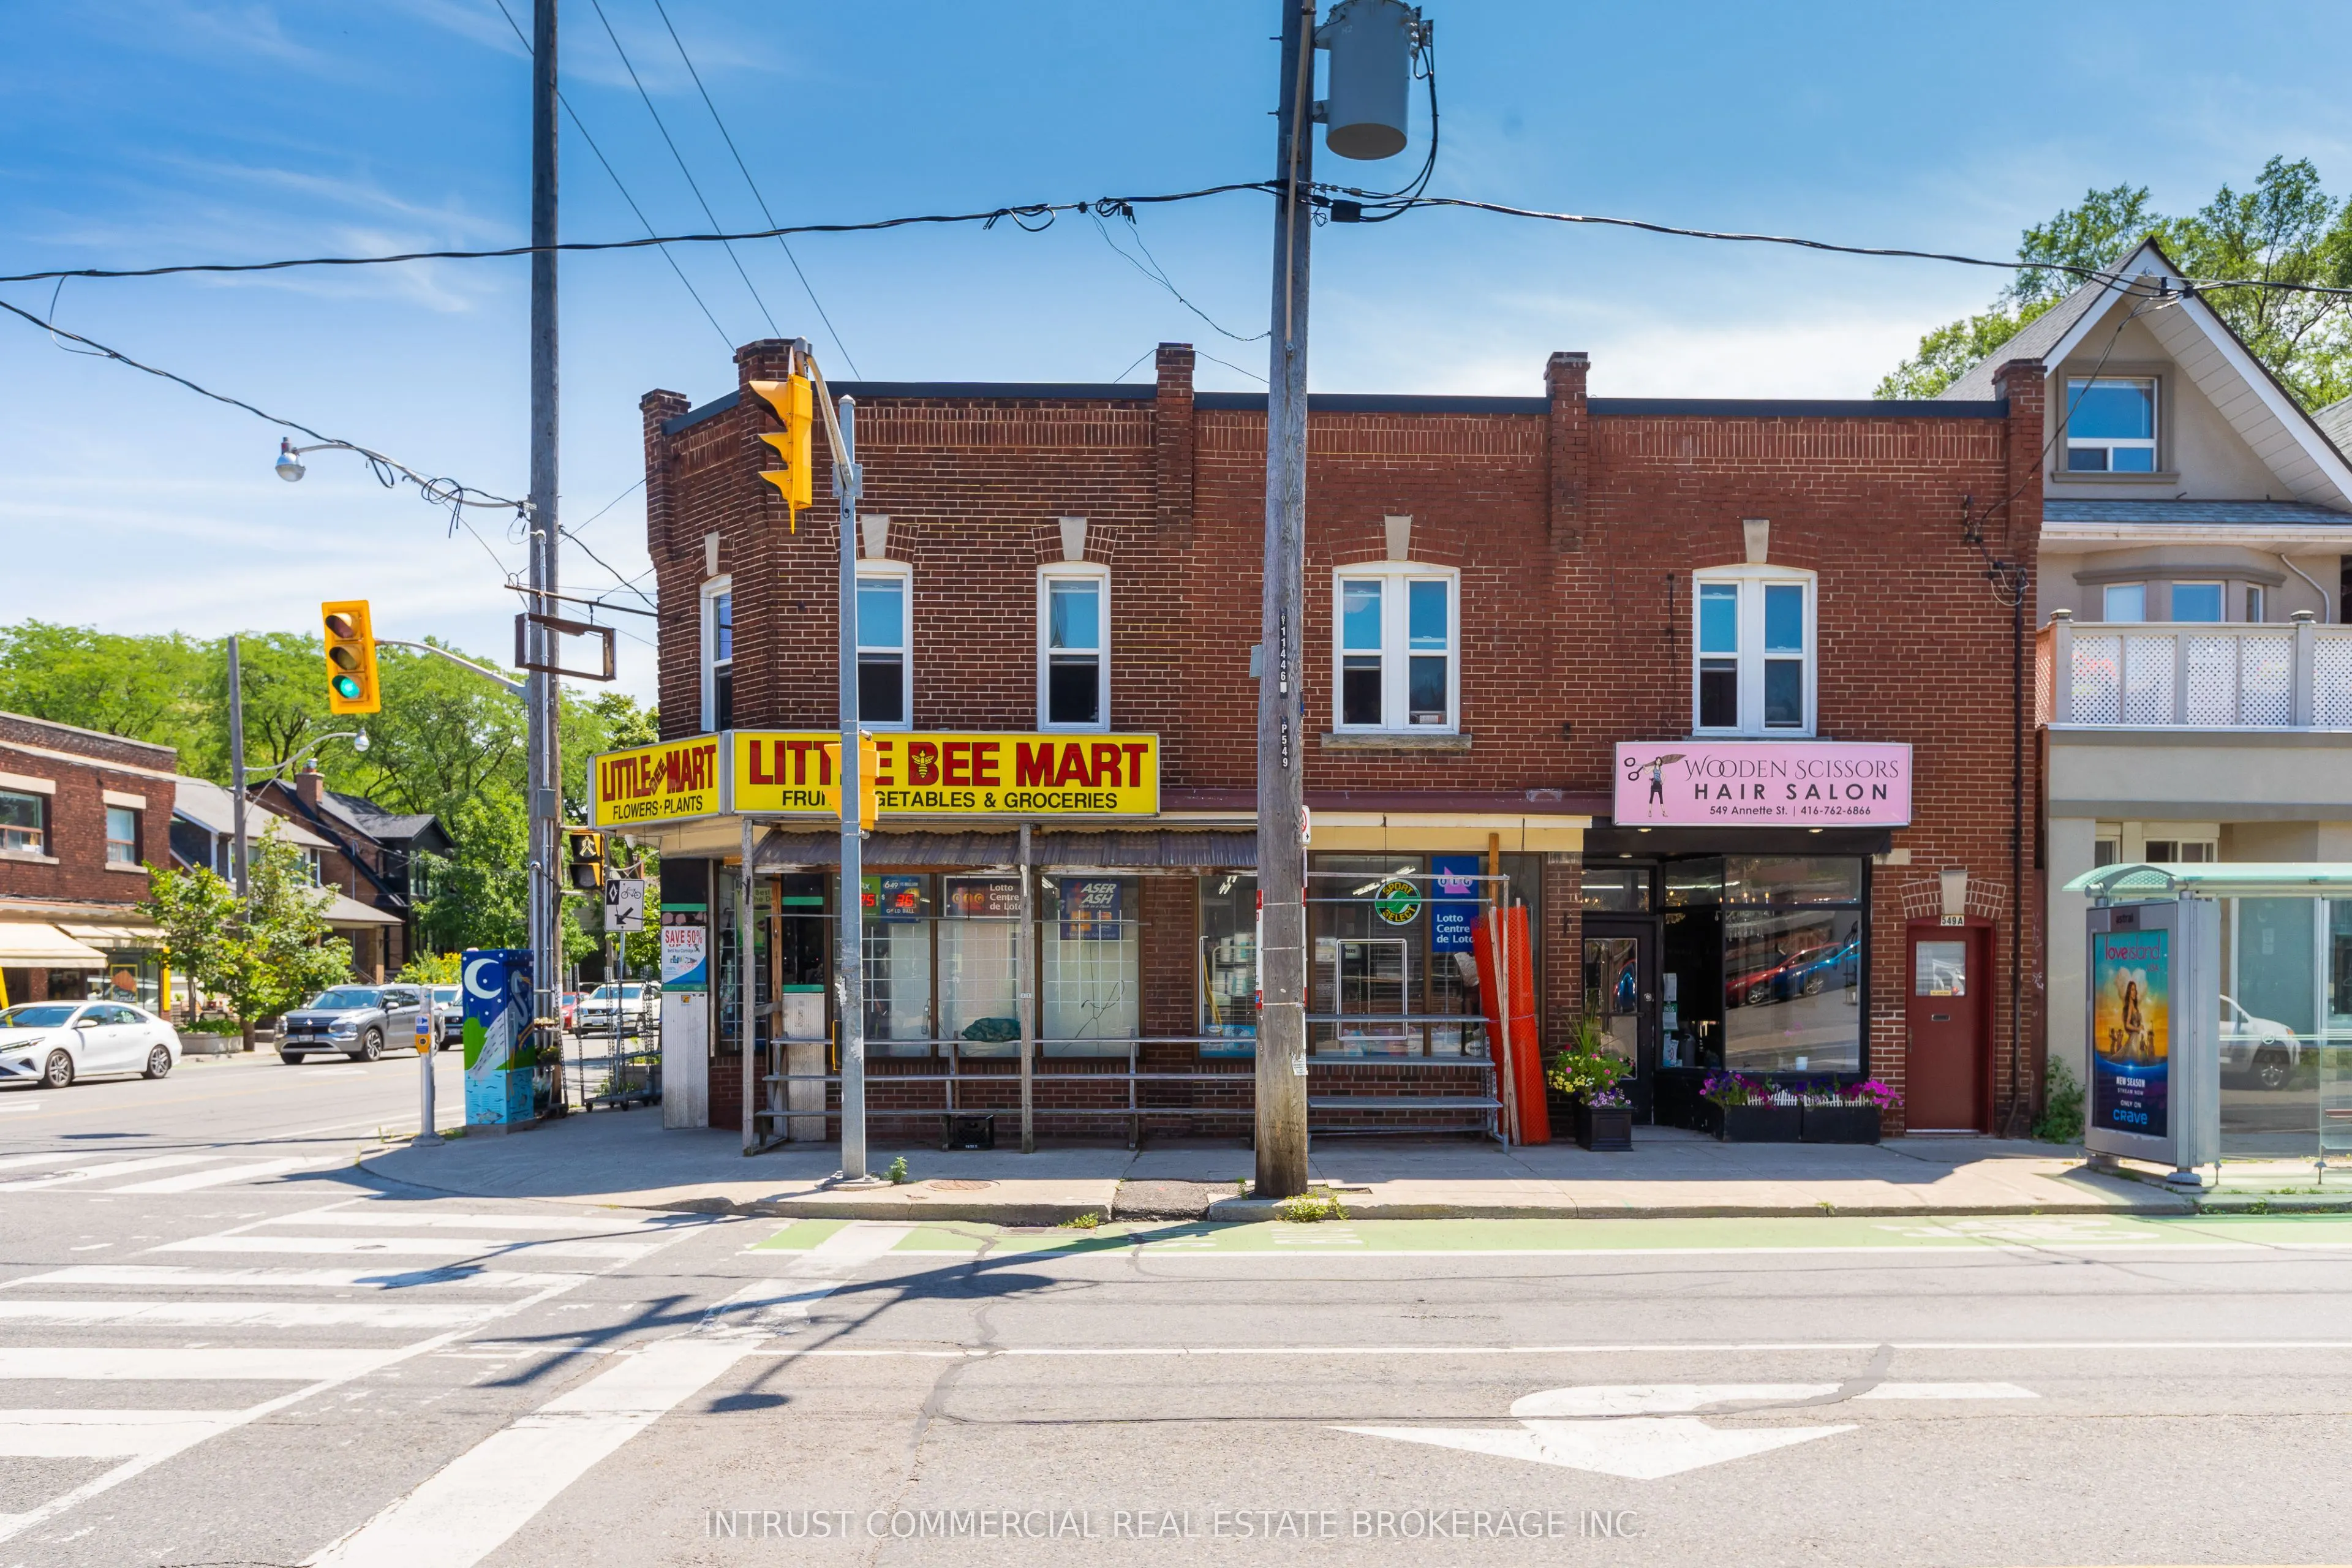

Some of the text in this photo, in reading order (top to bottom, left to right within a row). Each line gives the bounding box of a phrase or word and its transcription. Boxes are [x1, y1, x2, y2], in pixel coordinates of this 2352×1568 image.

[750, 740, 1148, 788] LITTE BEE MART
[1685, 755, 1899, 782] WOODEN SCISSORS
[602, 744, 716, 802] LITTLE BEE MART
[1695, 783, 1888, 801] HAIR SALON
[876, 791, 976, 808] GETABLES
[984, 792, 997, 808] &
[1004, 792, 1118, 809] GROCERIES
[613, 795, 703, 820] FLOWERS PLANTS
[1709, 805, 1871, 815] 549 Annette St. 416-762-6866
[1382, 882, 1414, 895] SPORT
[989, 893, 1020, 902] Centre
[1382, 905, 1417, 922] SELECT
[1436, 914, 1463, 922] Lotto
[2116, 913, 2133, 924] astral
[1942, 916, 1964, 925] 549A
[1436, 924, 1470, 933] Centre
[665, 930, 703, 944] SAVE 50%
[1436, 935, 1449, 943] de
[2116, 1076, 2146, 1088] NEW SEASON
